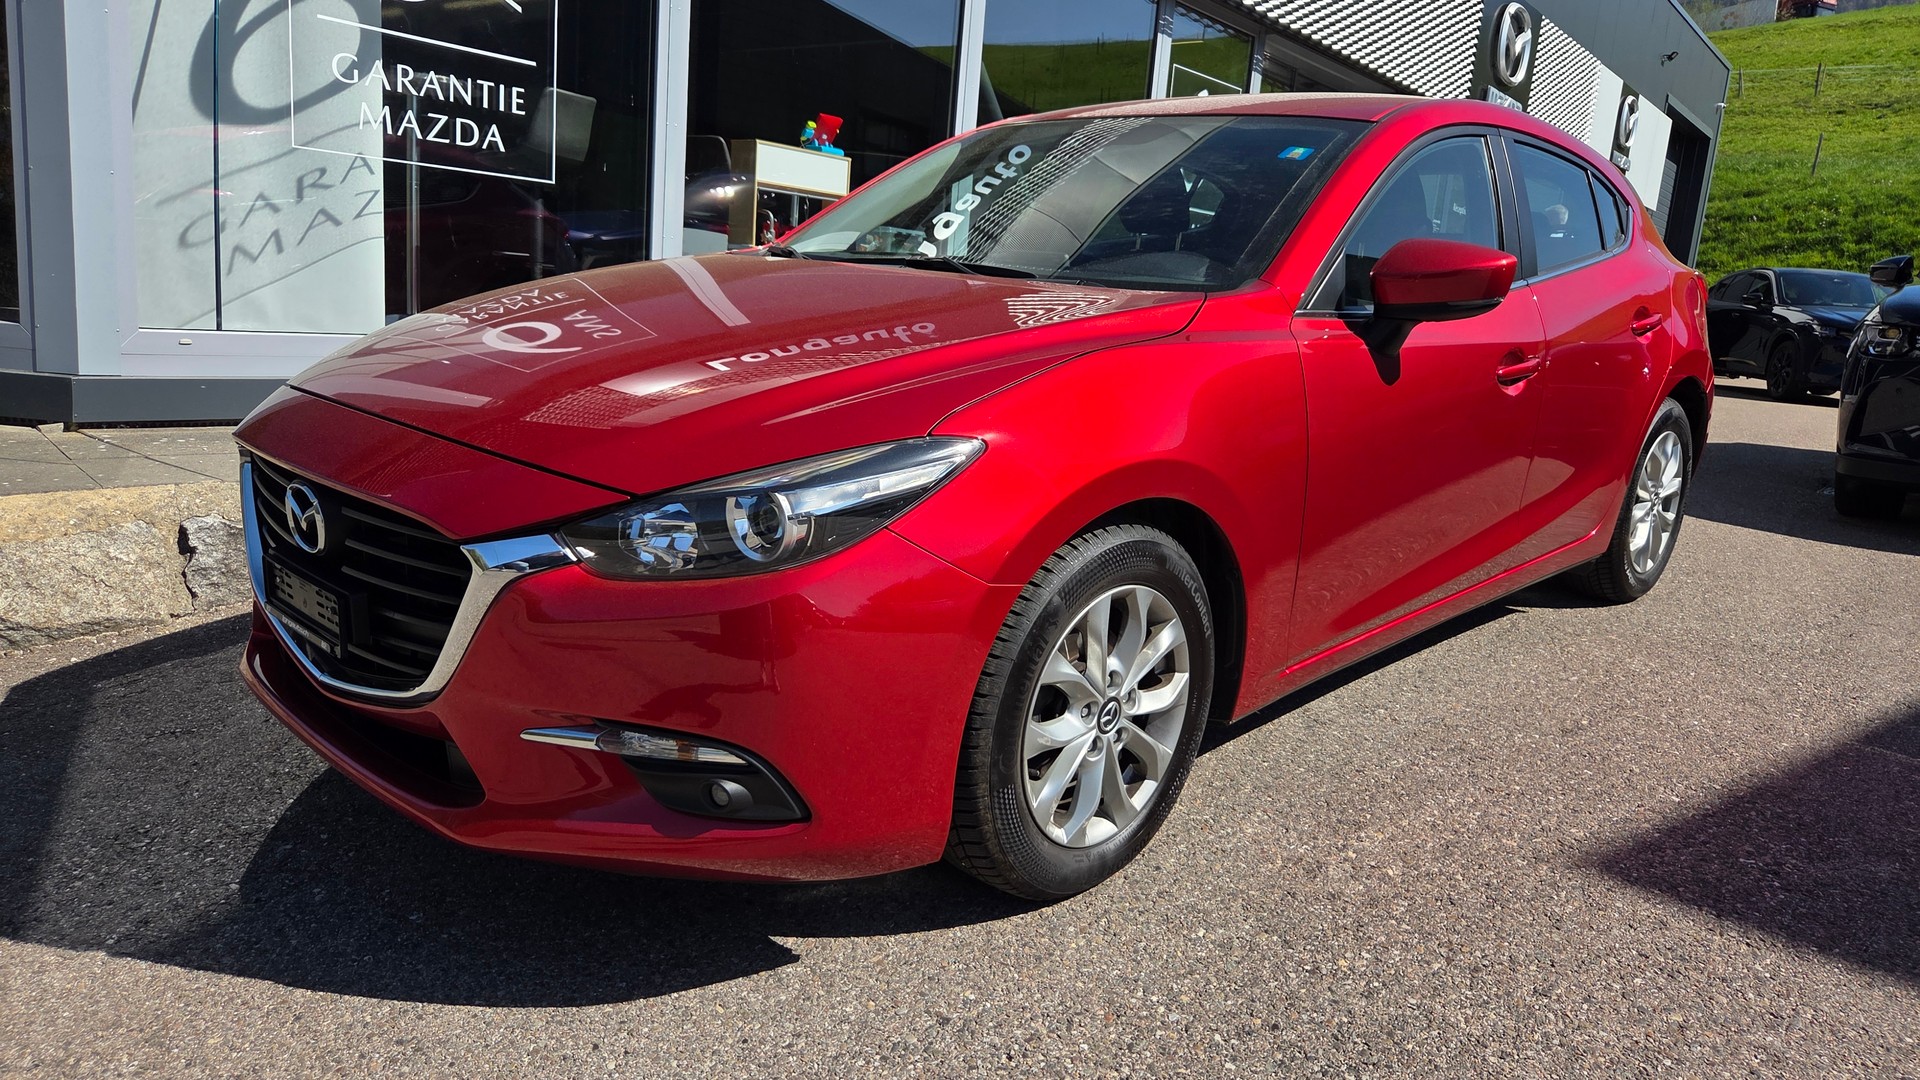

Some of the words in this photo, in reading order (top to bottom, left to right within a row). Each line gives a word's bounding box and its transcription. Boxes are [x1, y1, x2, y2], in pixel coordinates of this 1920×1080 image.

[331, 52, 526, 116] GARANTIE
[358, 101, 506, 152] MAZDA
[1165, 554, 1212, 639] WinterContact
